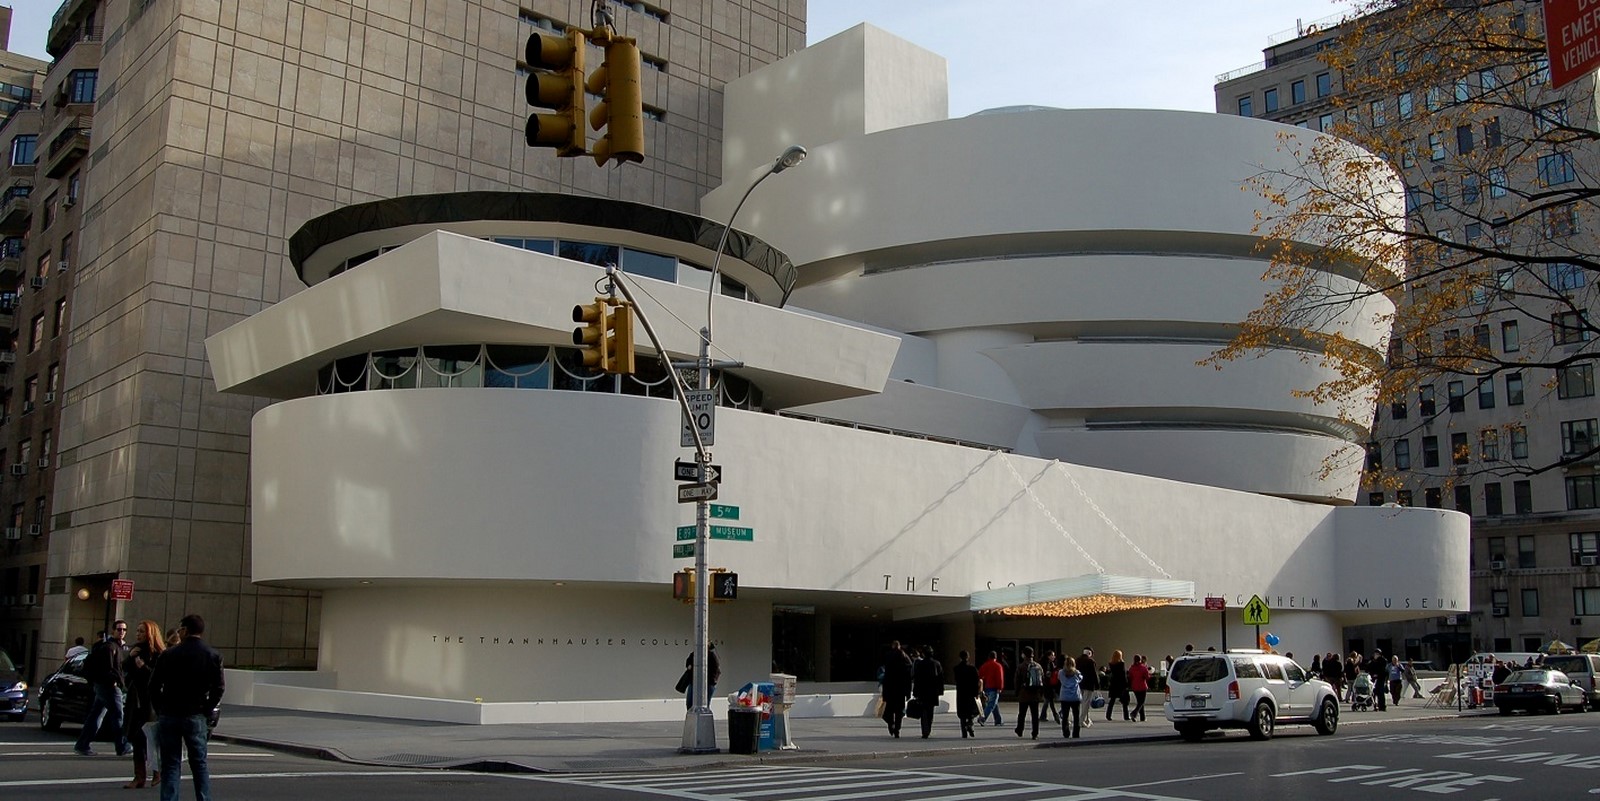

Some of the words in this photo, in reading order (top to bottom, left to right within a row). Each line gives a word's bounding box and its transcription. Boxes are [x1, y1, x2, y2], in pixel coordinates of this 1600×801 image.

[686, 393, 713, 403] SPEED
[687, 403, 709, 411] IMIT
[680, 467, 697, 477] ONE
[683, 488, 695, 498] ONE
[717, 506, 724, 517] 5
[715, 527, 747, 537] MUSEUM
[883, 574, 940, 593] THE
[1356, 598, 1458, 609] MUSEUM
[432, 635, 464, 644] THE
[479, 636, 626, 646] THANNHAUSER
[1268, 764, 1524, 794] FIRE
